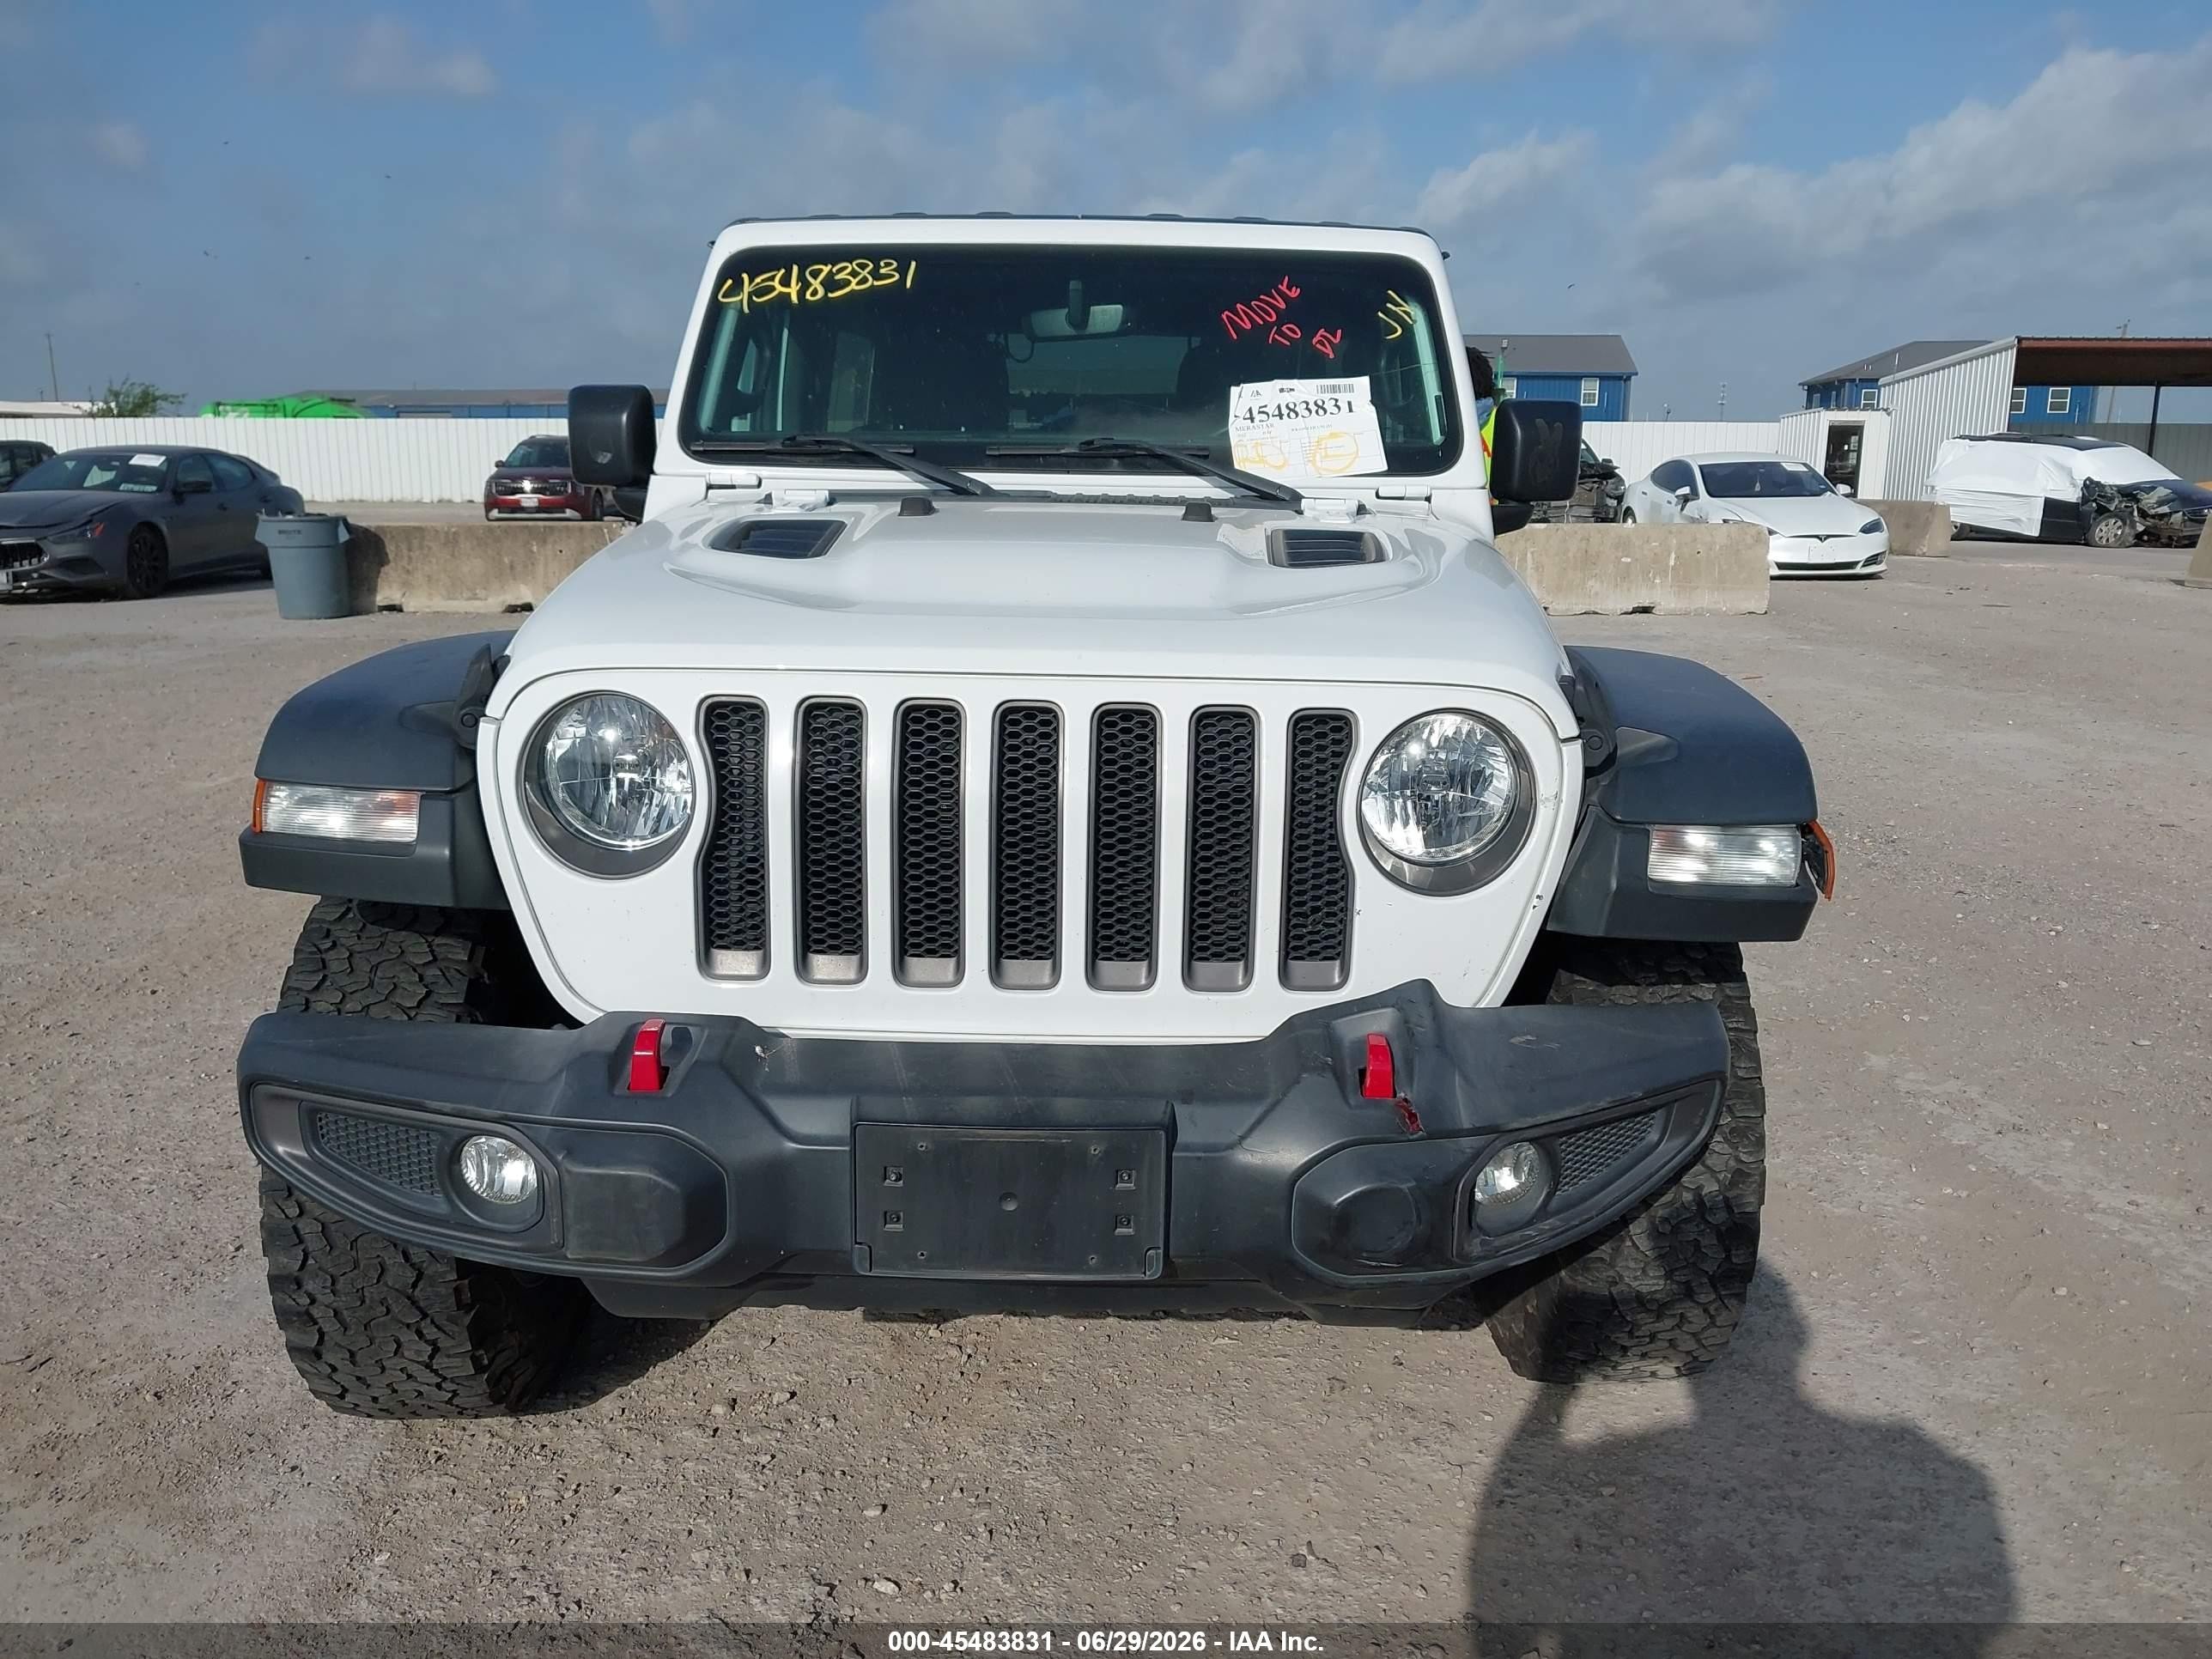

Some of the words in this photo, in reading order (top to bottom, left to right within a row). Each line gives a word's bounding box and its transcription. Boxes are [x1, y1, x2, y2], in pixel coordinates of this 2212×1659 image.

[718, 259, 916, 313] 45483831
[1220, 276, 1301, 340] MOVE
[1268, 323, 1302, 346] TO
[1243, 397, 1355, 424] 45483831
